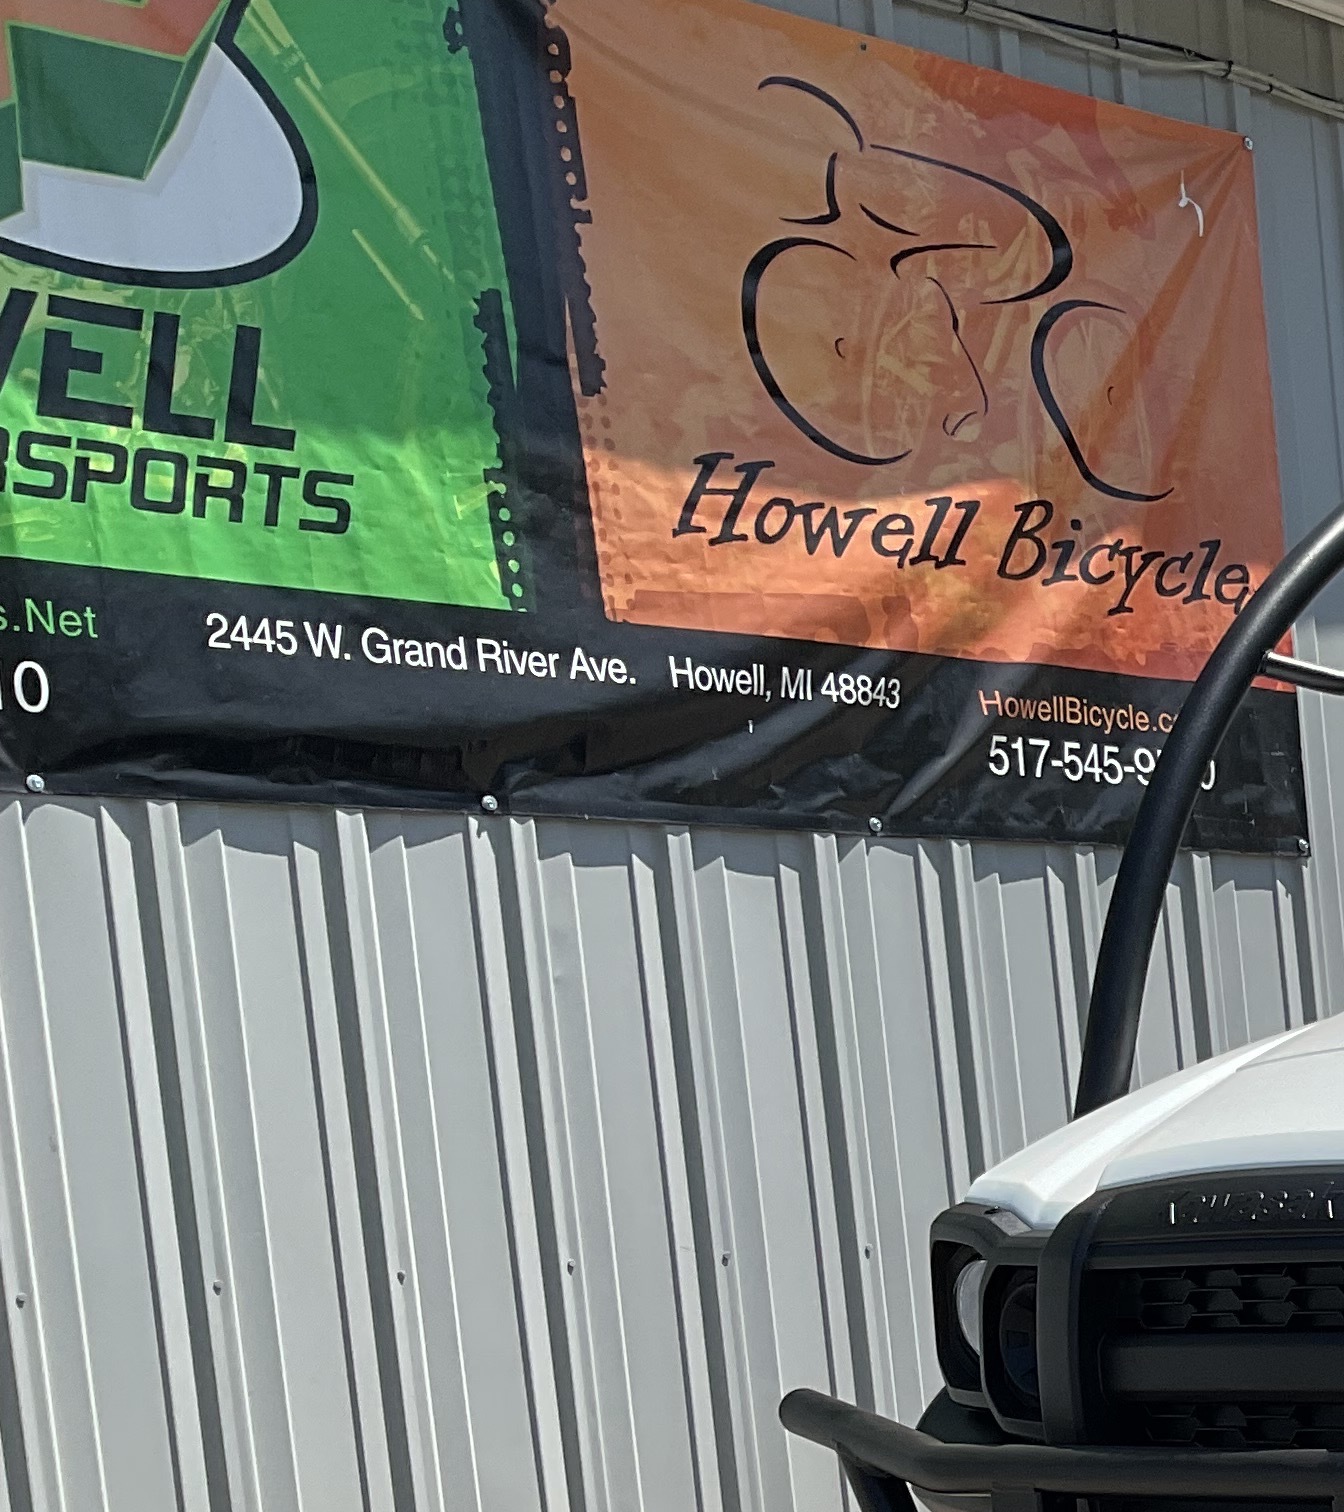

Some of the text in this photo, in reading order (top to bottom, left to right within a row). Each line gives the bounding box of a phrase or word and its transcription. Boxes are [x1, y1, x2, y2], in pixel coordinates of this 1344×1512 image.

[0, 427, 355, 534] SPORTS
[672, 452, 1252, 616] Howell Bicycle
[205, 612, 901, 710] 2445 W. Grand River Ave. Howell, MI 48843
[978, 689, 1179, 735] HowellBicycle.c
[988, 734, 1217, 791] 517-545-9
